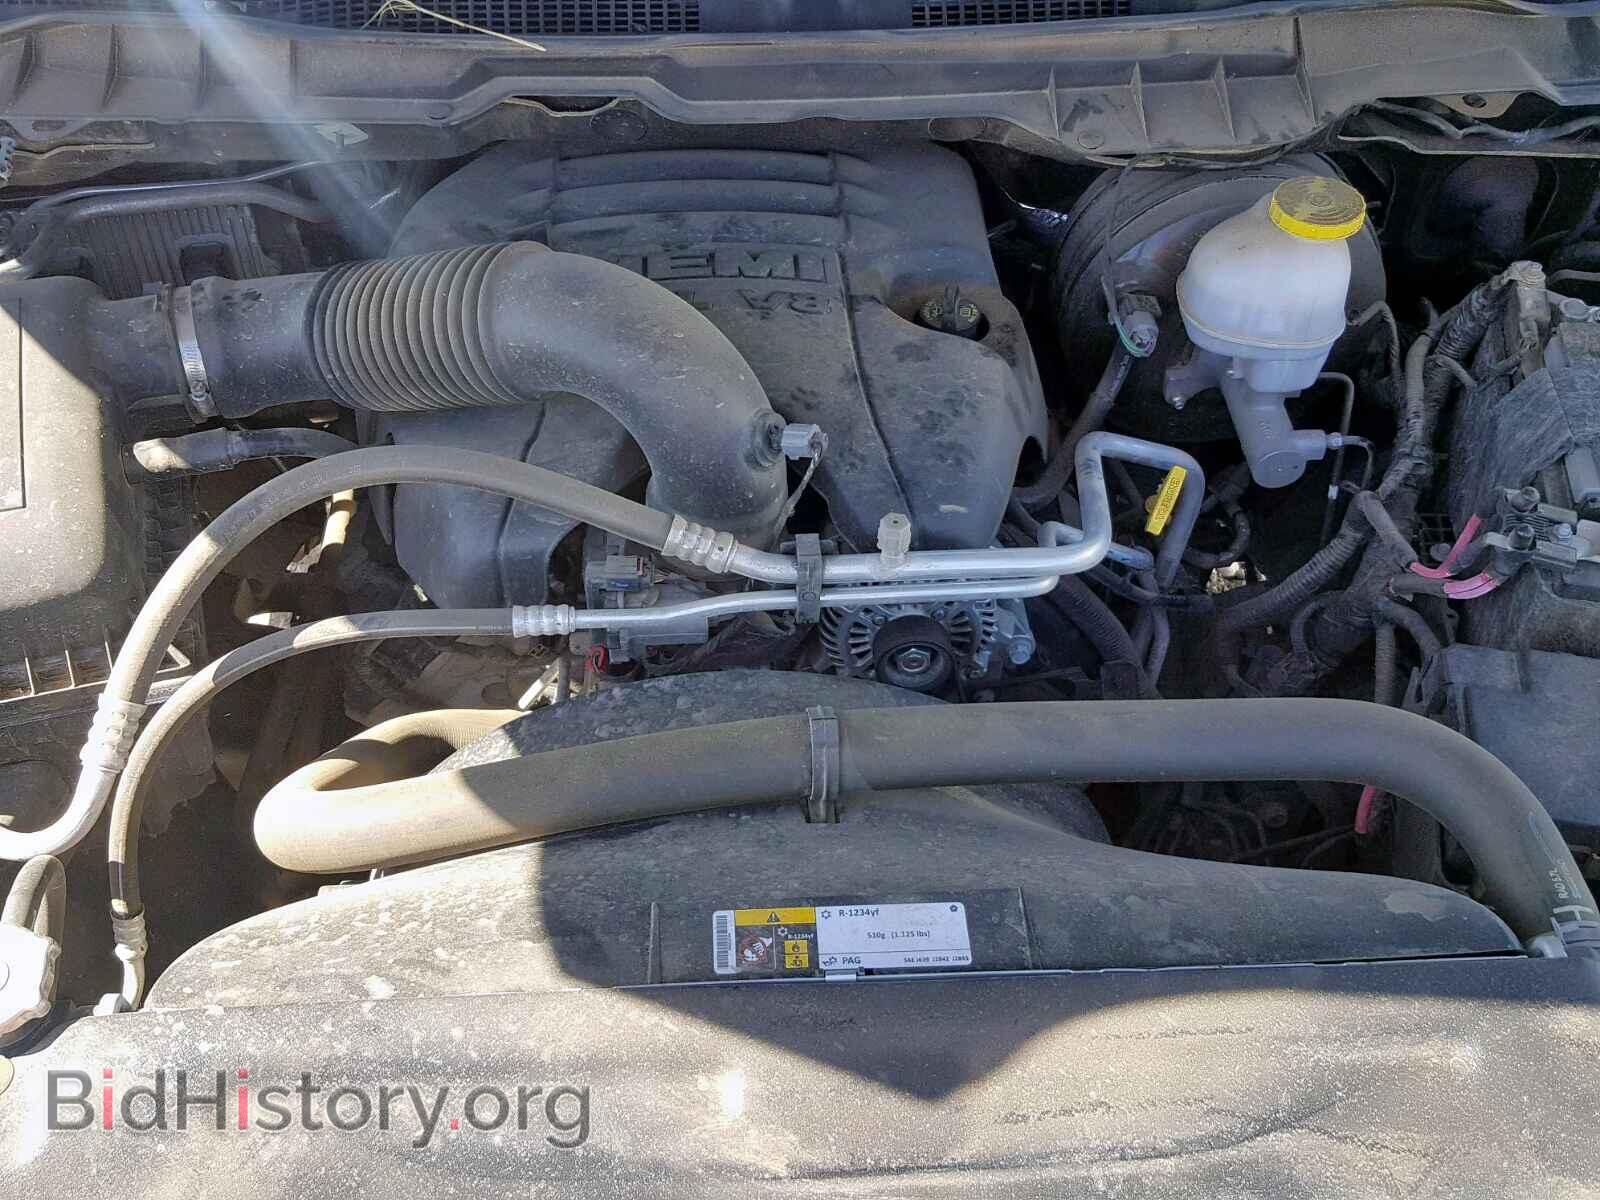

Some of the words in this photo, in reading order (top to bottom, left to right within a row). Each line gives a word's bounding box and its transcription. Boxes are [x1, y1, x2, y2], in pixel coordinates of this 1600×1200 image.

[838, 908, 880, 918] R-1234yf
[867, 931, 886, 940] 510g
[842, 956, 862, 966] PAG
